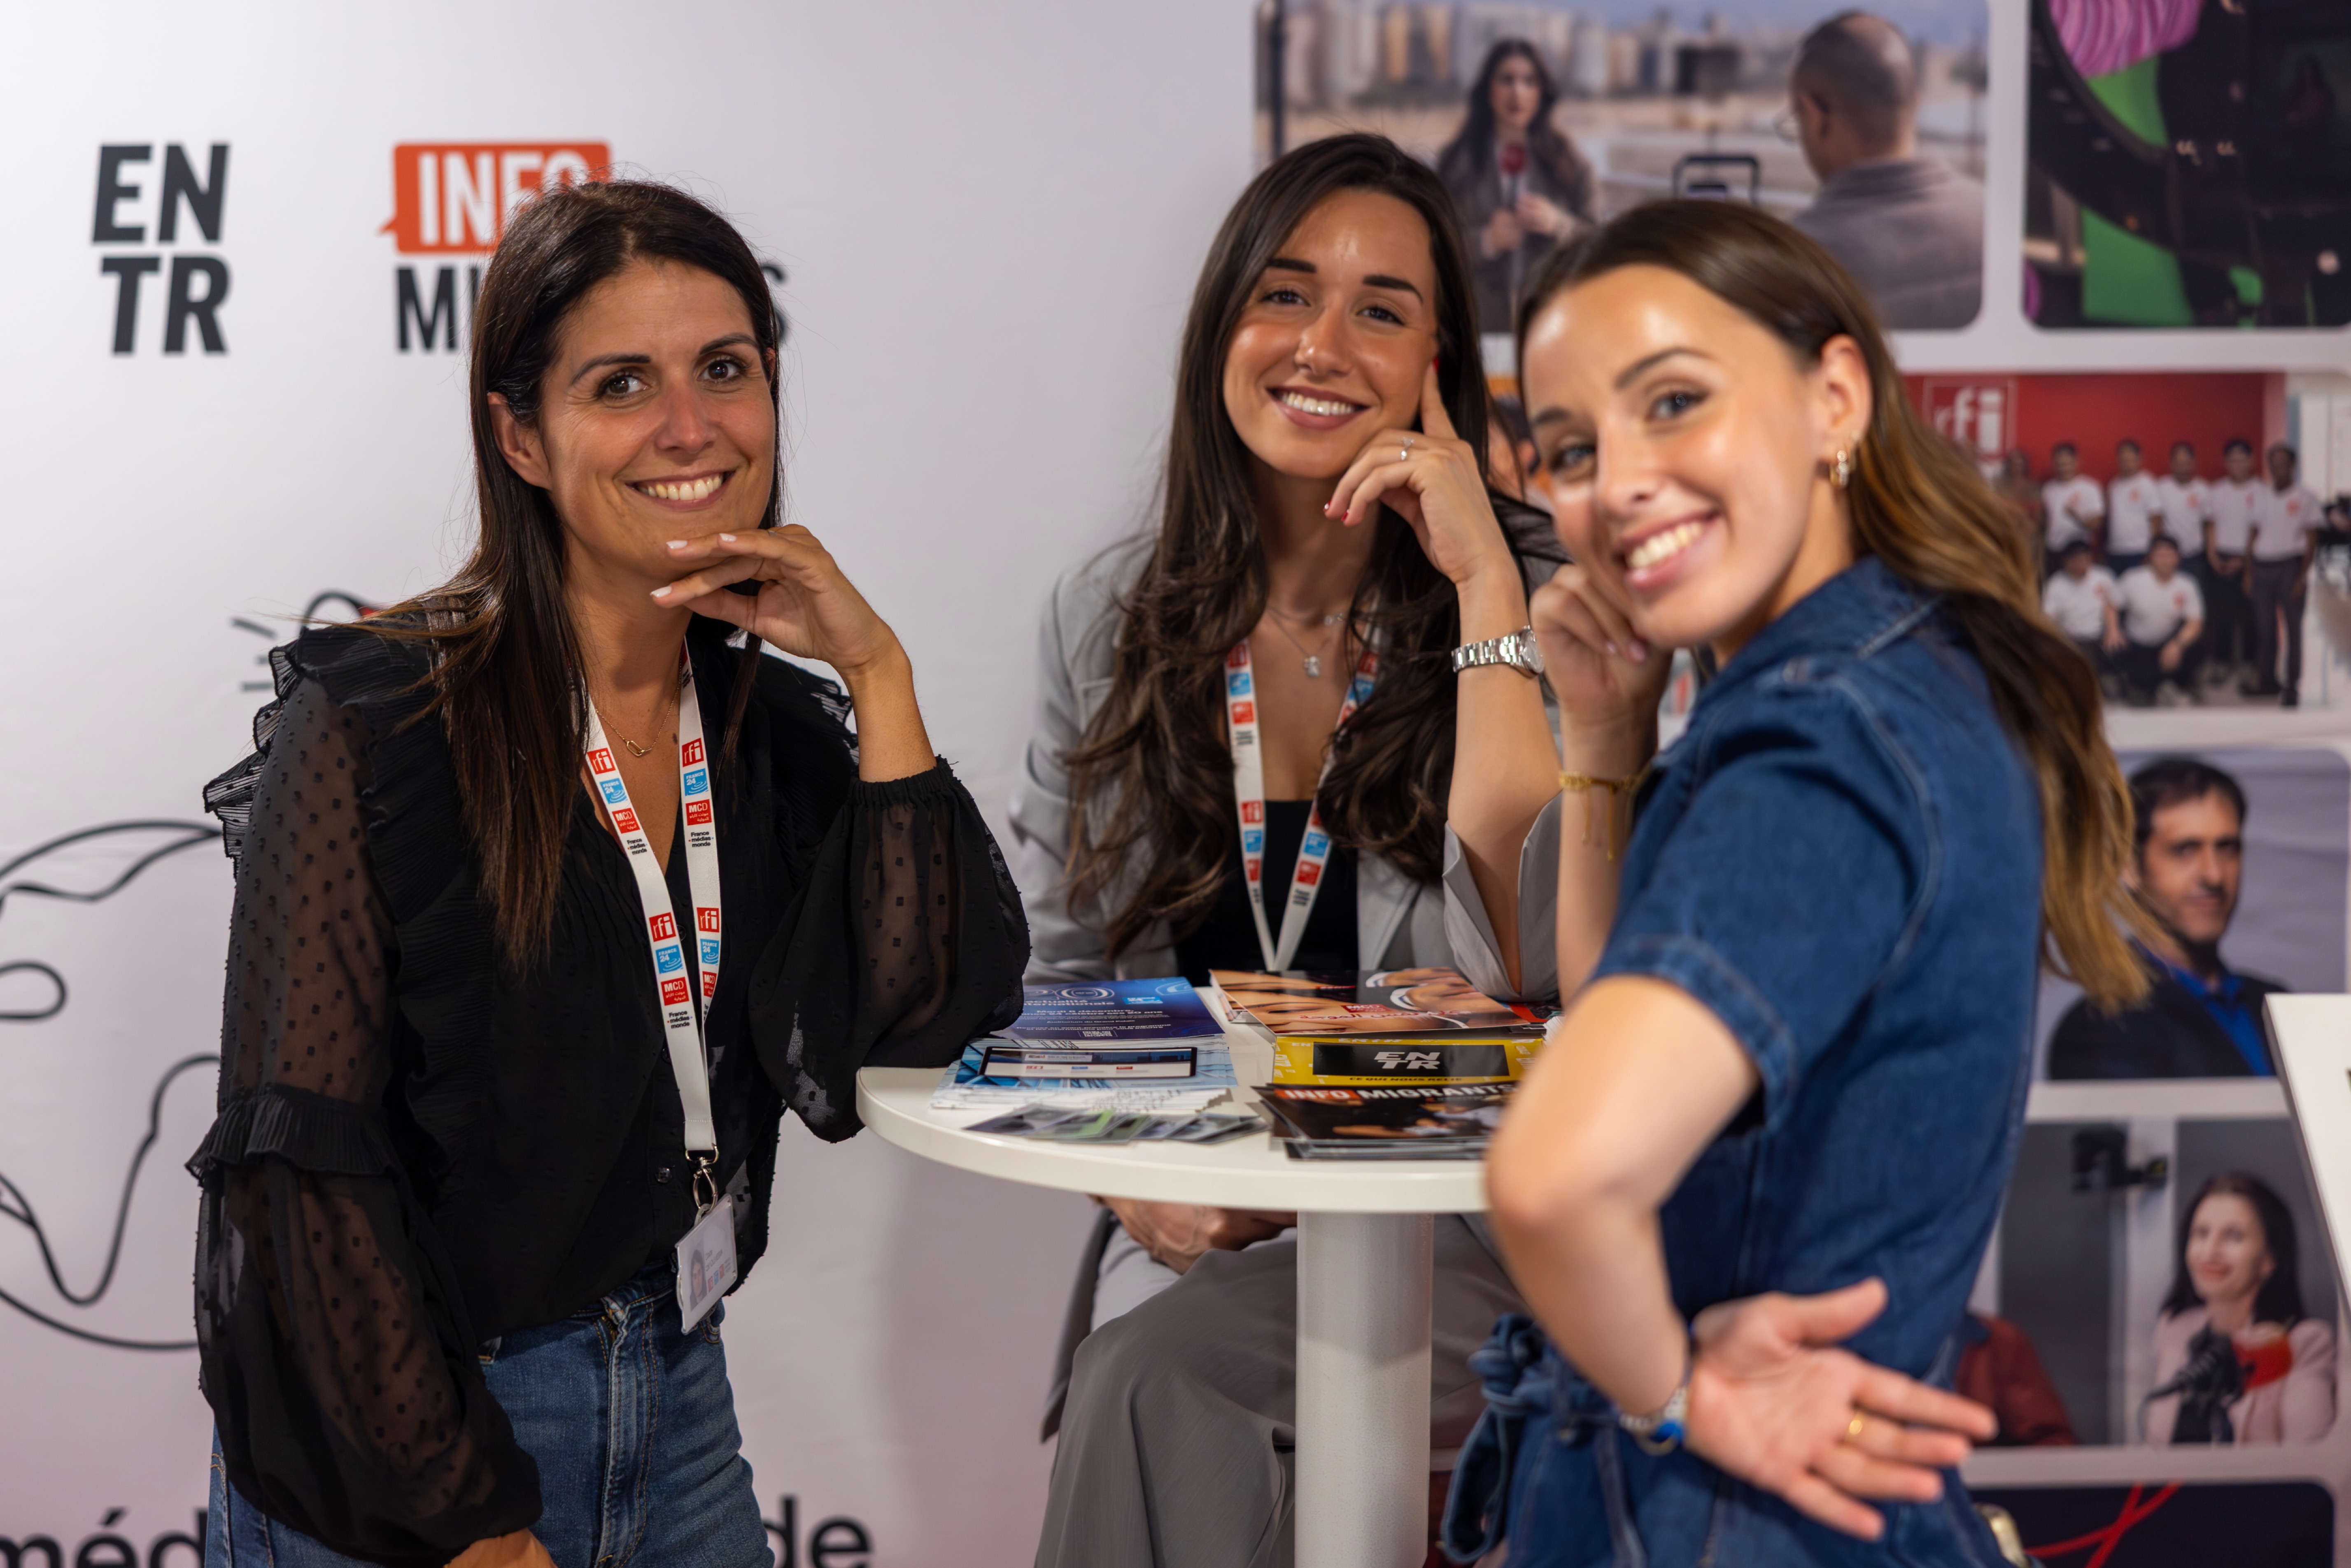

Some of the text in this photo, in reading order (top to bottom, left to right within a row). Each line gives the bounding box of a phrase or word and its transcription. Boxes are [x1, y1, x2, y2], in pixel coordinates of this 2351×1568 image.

[92, 144, 229, 243] EN
[101, 255, 230, 354] TR
[684, 742, 702, 764] rfi
[592, 751, 611, 772] rfi
[686, 771, 704, 780] FRANCE
[689, 803, 708, 812] MCD
[617, 811, 633, 821] MCD
[700, 910, 717, 929] rfi
[652, 916, 673, 940] rfi
[704, 974, 715, 984] MCD
[664, 981, 684, 992] MCD
[1374, 1052, 1440, 1061] EN
[1377, 1060, 1440, 1069] TR
[1284, 1089, 1351, 1100] INFO
[1356, 1084, 1517, 1100] MIGRANTS
